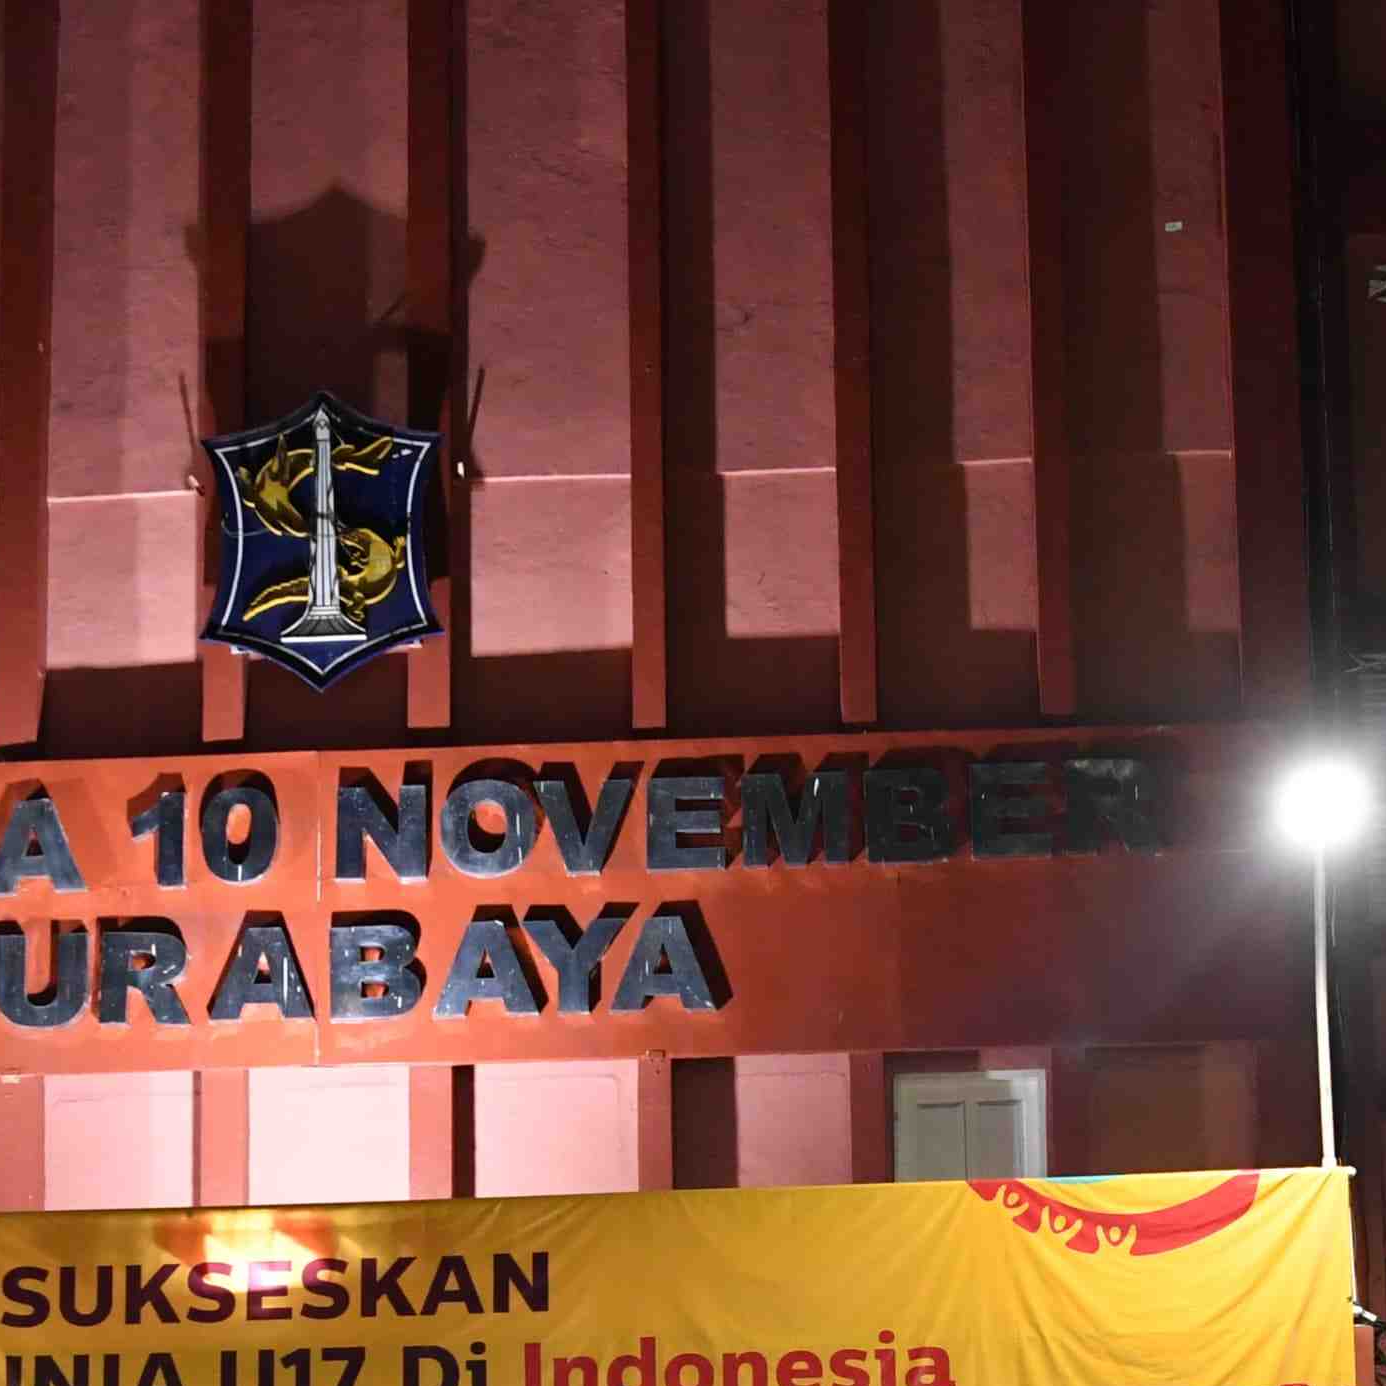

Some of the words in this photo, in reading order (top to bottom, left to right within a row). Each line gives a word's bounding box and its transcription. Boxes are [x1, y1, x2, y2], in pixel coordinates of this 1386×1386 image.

[130, 776, 278, 890] 10
[333, 762, 1166, 882] NOVEMBER
[0, 1250, 550, 1329] SUKSESKAN
